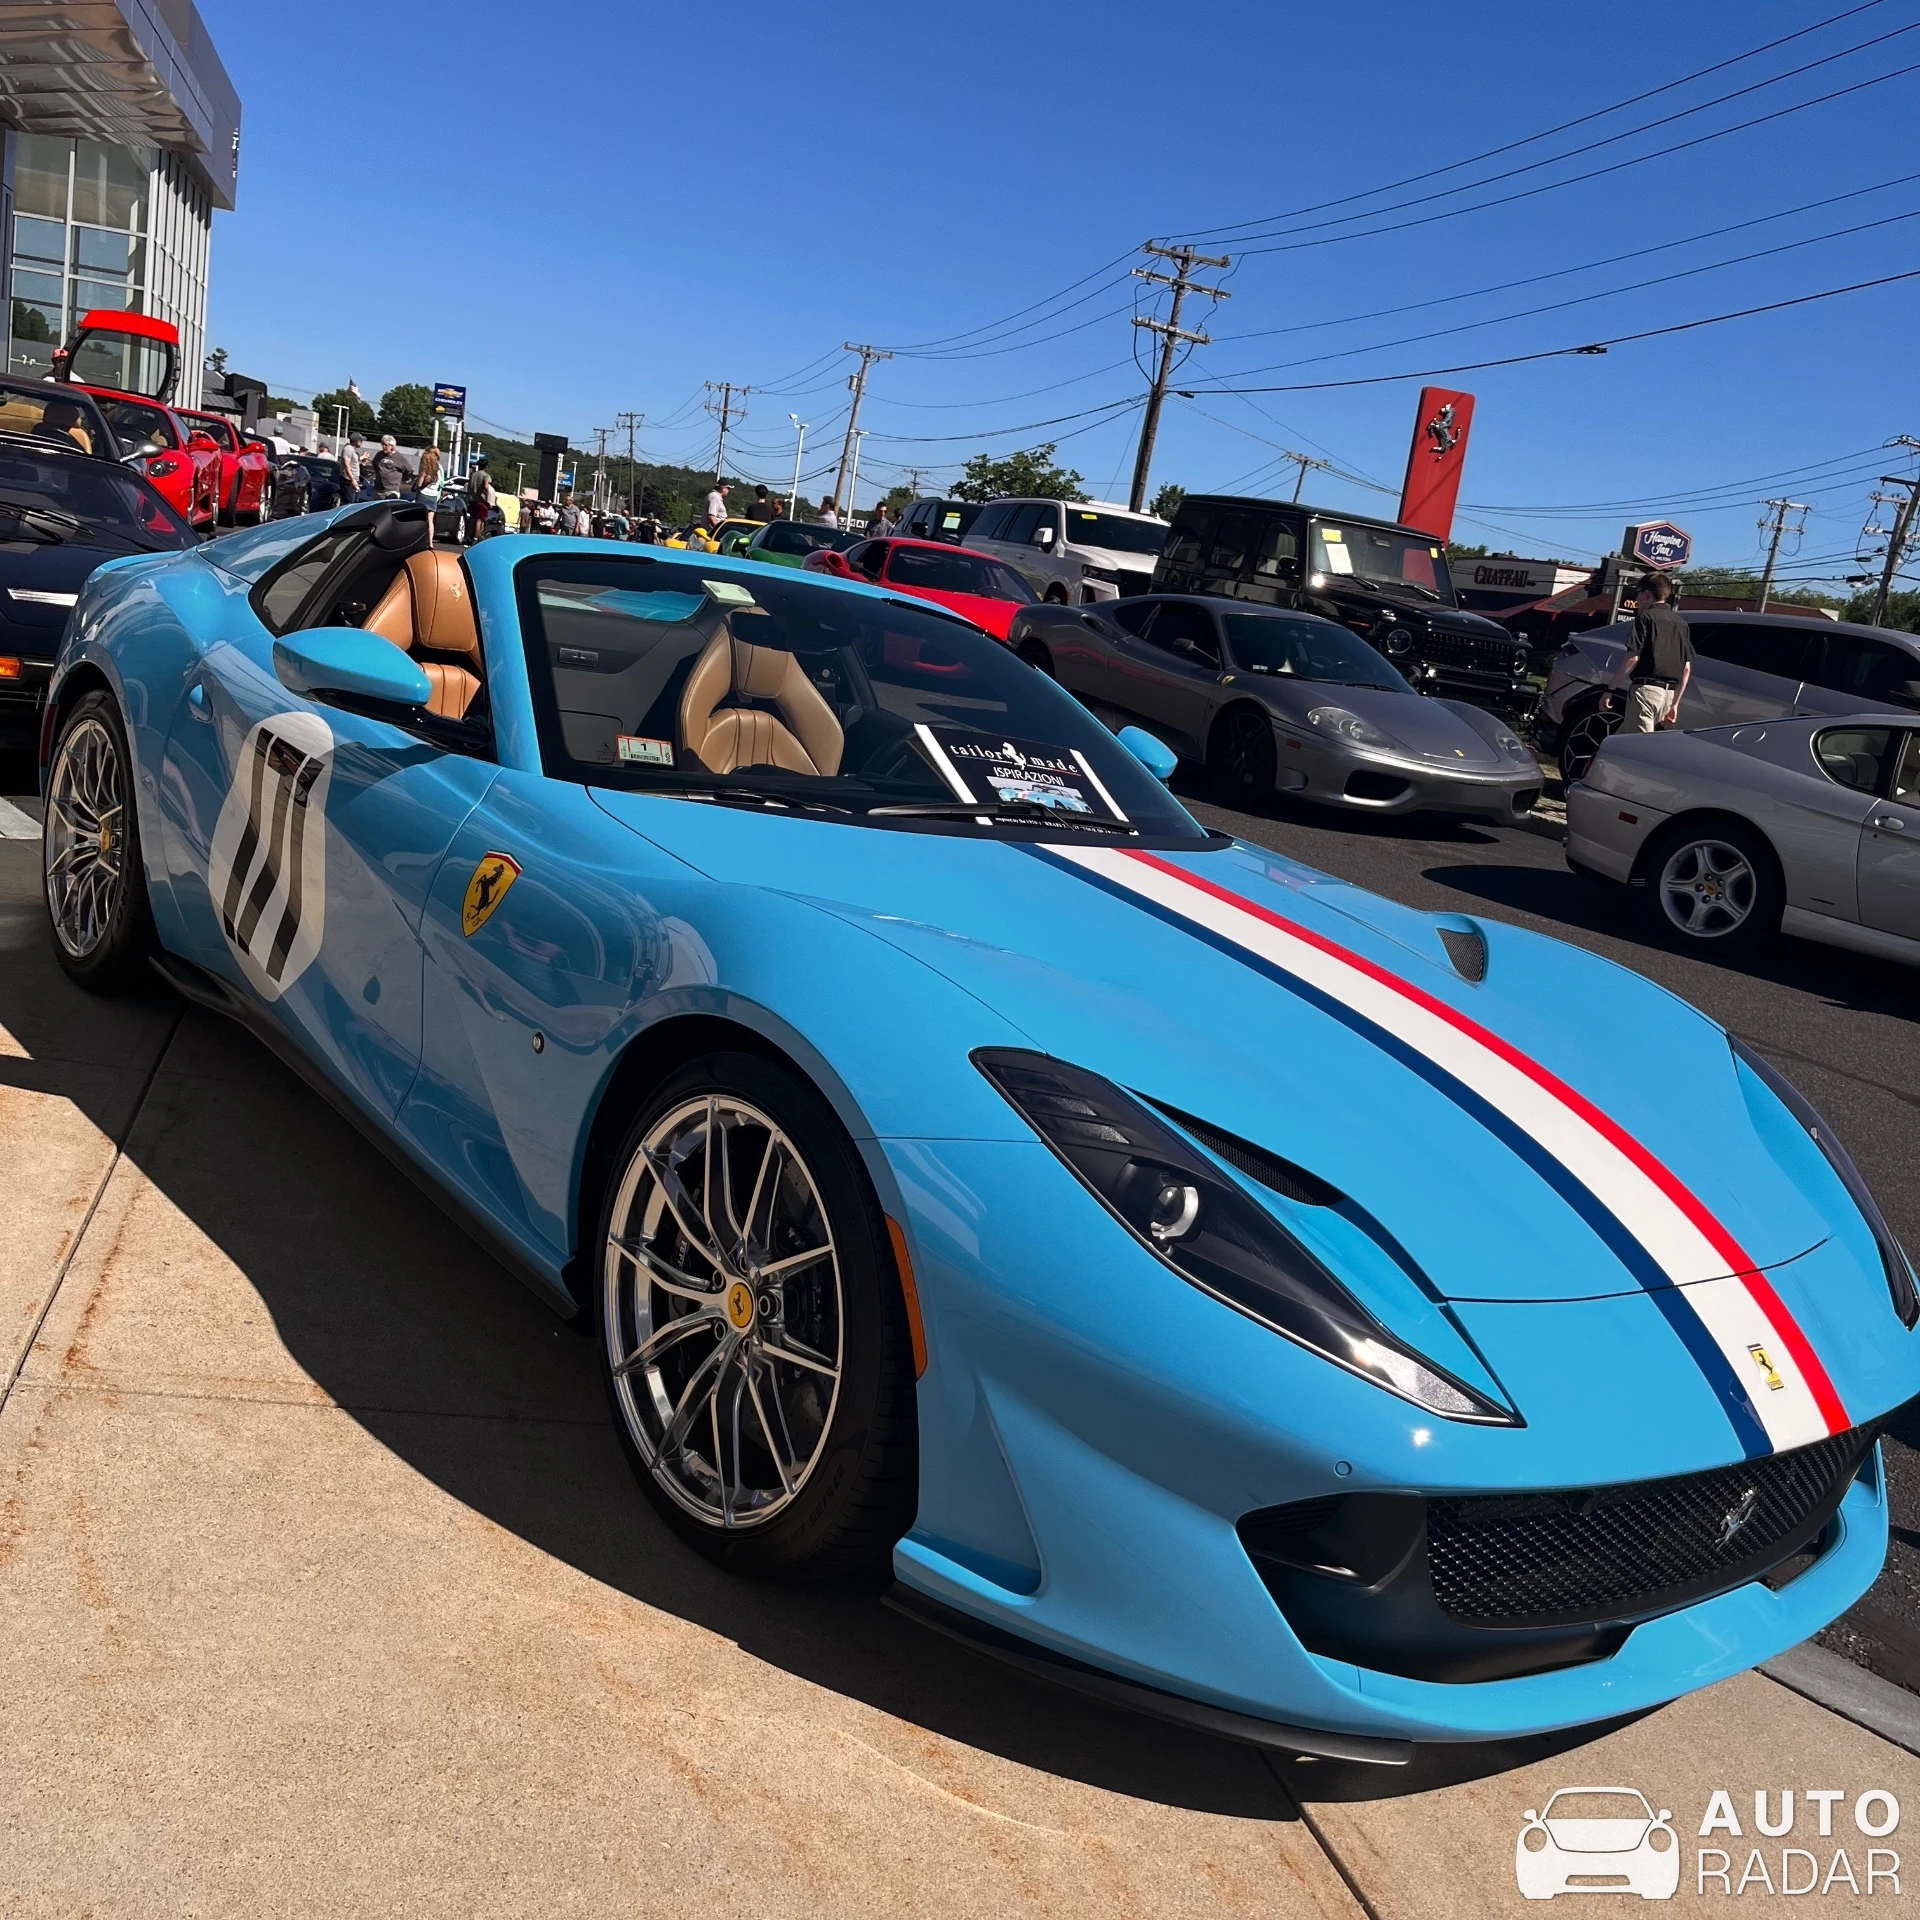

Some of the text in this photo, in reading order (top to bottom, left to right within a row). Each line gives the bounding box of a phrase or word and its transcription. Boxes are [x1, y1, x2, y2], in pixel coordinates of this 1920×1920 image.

[435, 397, 463, 405] CHEVROLET
[1644, 530, 1685, 549] Hampton
[1651, 543, 1674, 556] Inn
[950, 744, 1078, 773] tailor made
[993, 766, 1065, 787] ISPIRAZIONI
